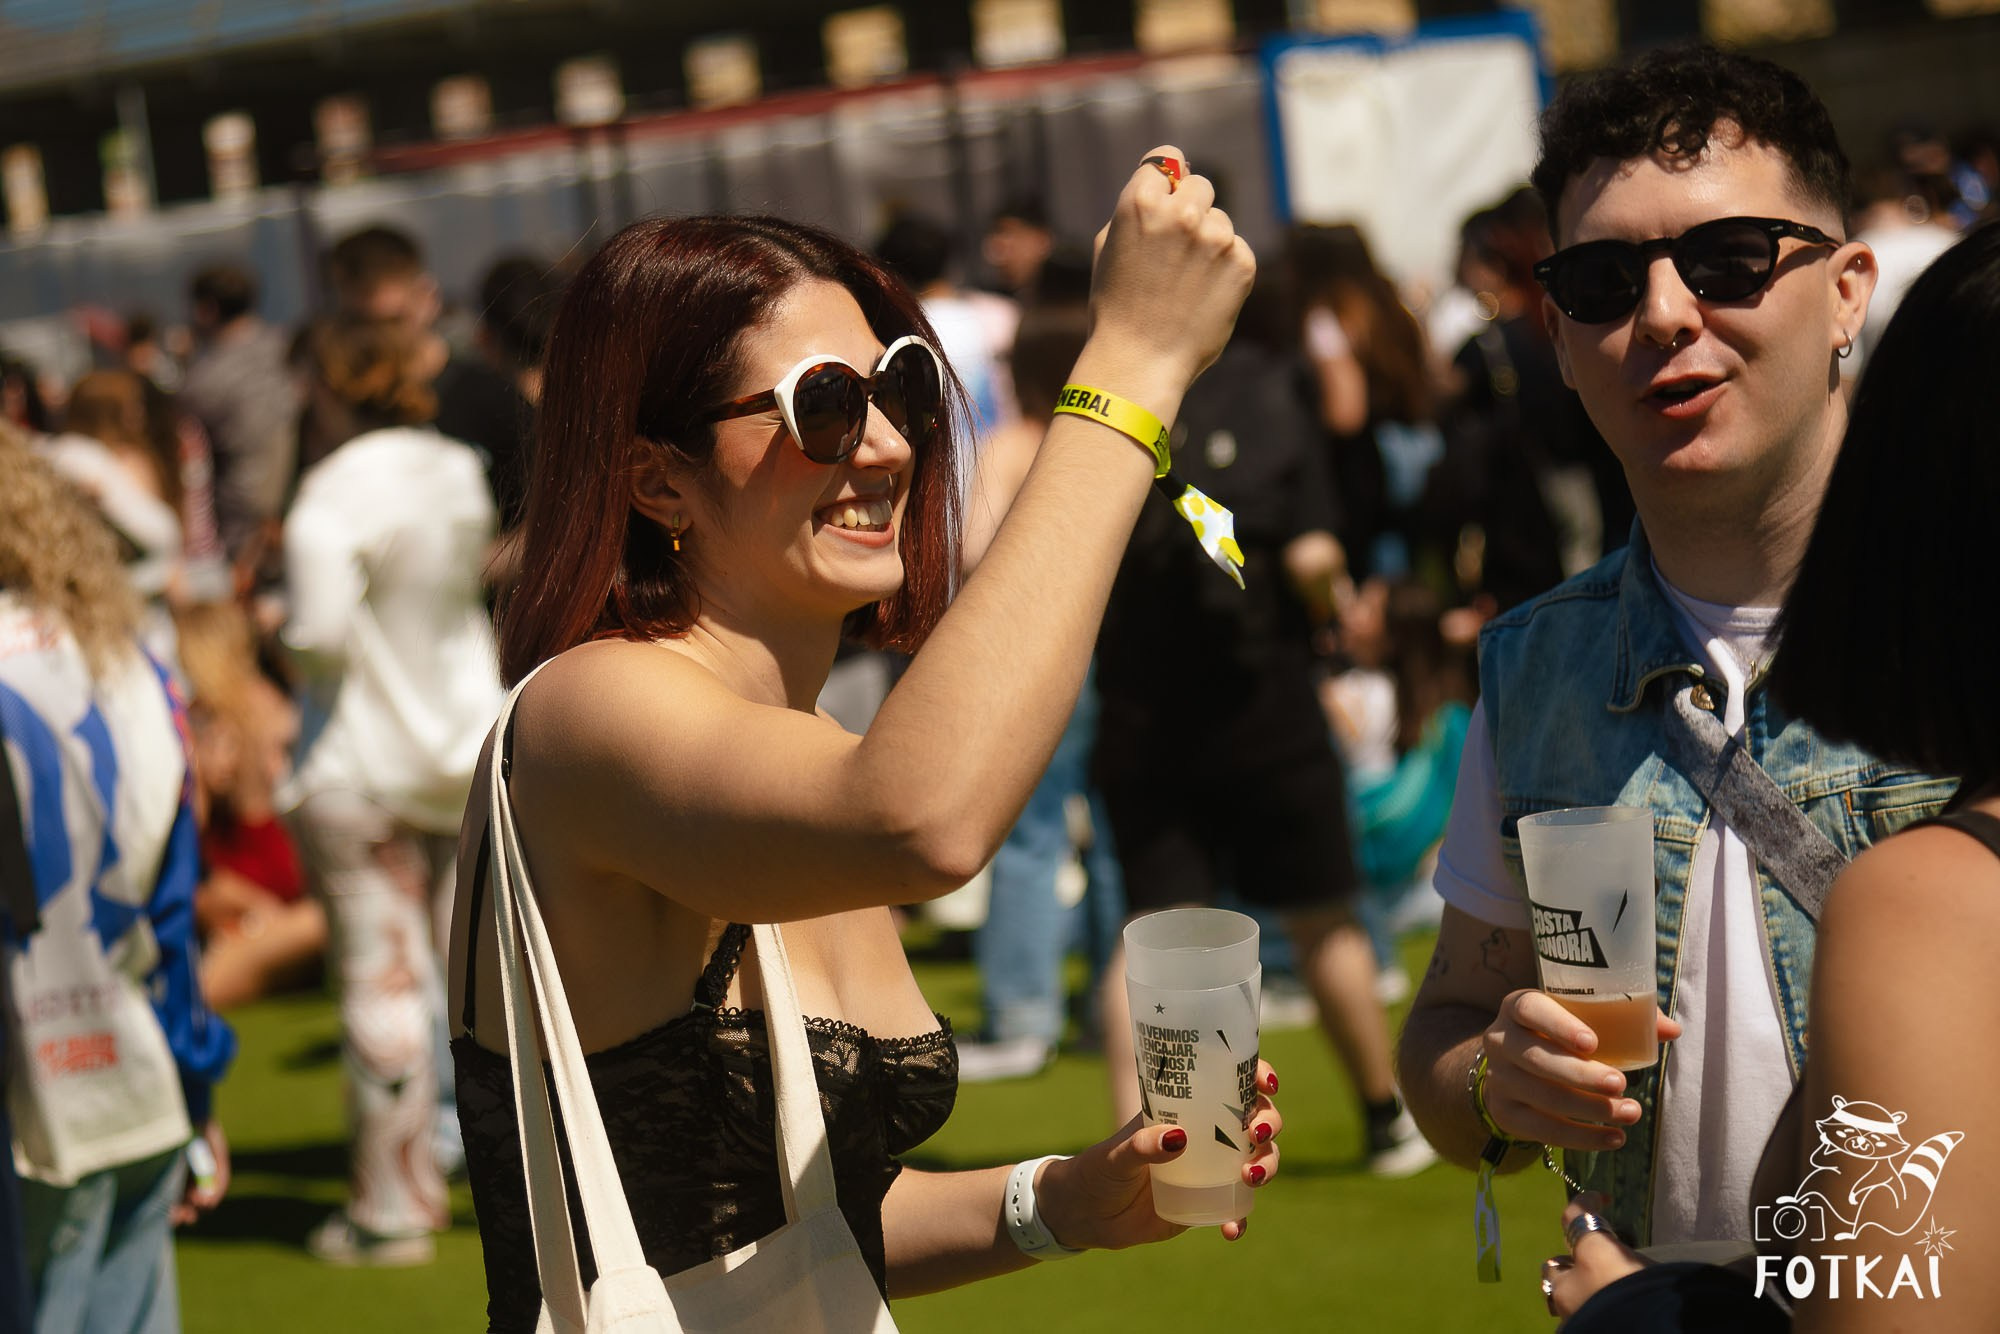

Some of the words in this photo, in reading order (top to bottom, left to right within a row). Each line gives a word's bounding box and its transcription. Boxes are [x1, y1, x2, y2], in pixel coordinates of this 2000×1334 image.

[1057, 388, 1111, 417] NERAL
[1146, 1024, 1200, 1043] VENIMOS
[1144, 1037, 1198, 1060] ENCAJAR,
[1187, 1058, 1196, 1071] A
[1237, 1060, 1249, 1078] NO
[1155, 1083, 1193, 1100] MOLDE
